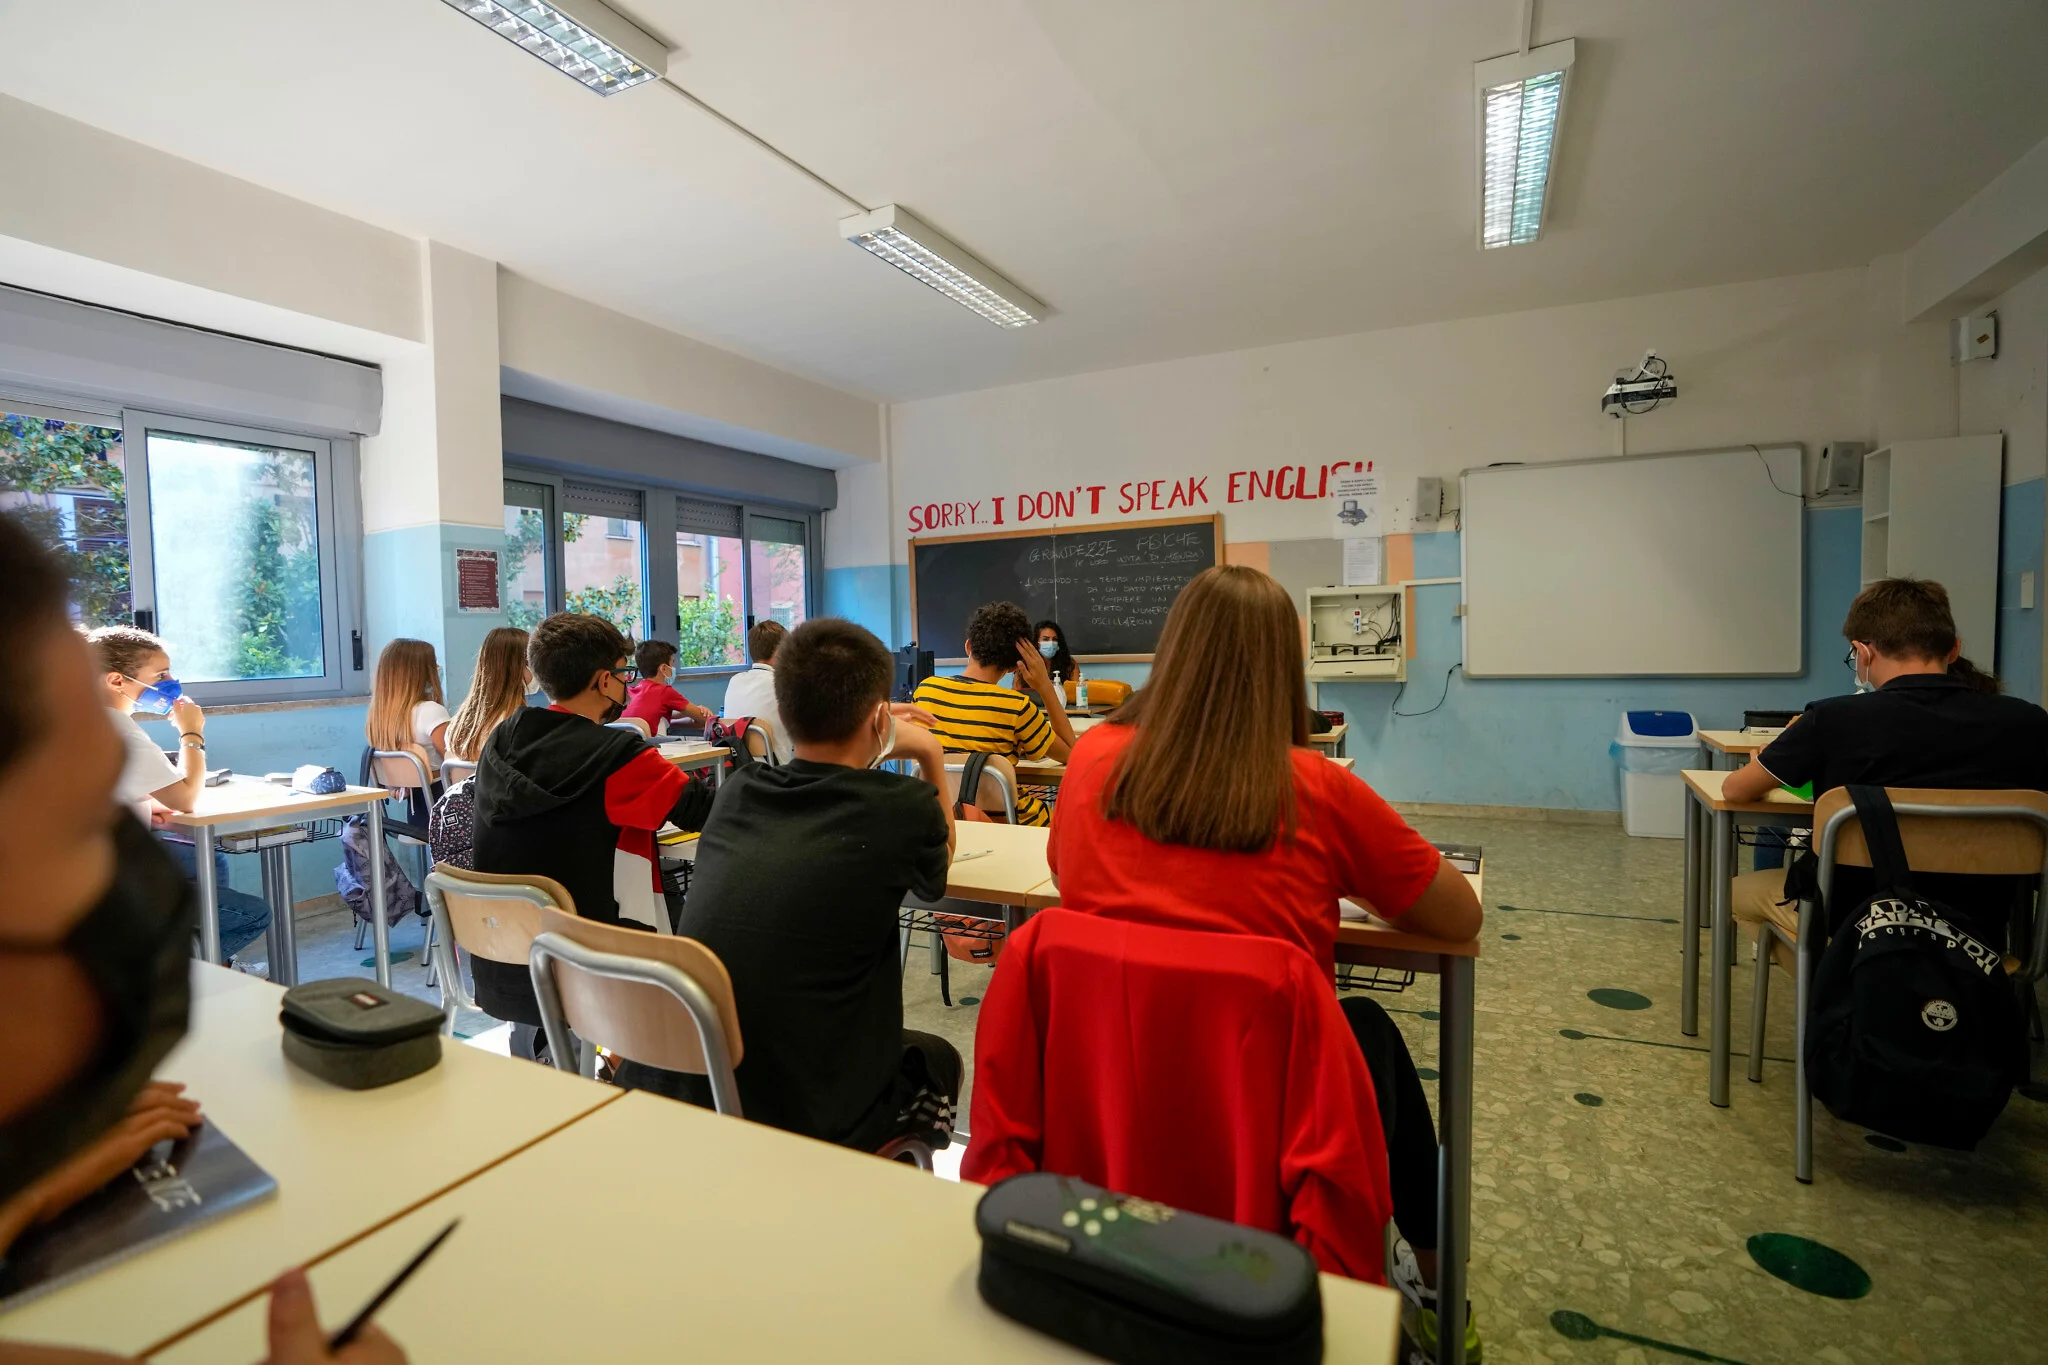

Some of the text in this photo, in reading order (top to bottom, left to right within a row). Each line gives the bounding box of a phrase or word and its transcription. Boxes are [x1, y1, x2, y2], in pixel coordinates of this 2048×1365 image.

[1018, 486, 1106, 522] DON'T
[1118, 476, 1208, 514] SPEAK
[1227, 461, 1373, 504] ENGLI
[1091, 604, 1123, 613] CERTO
